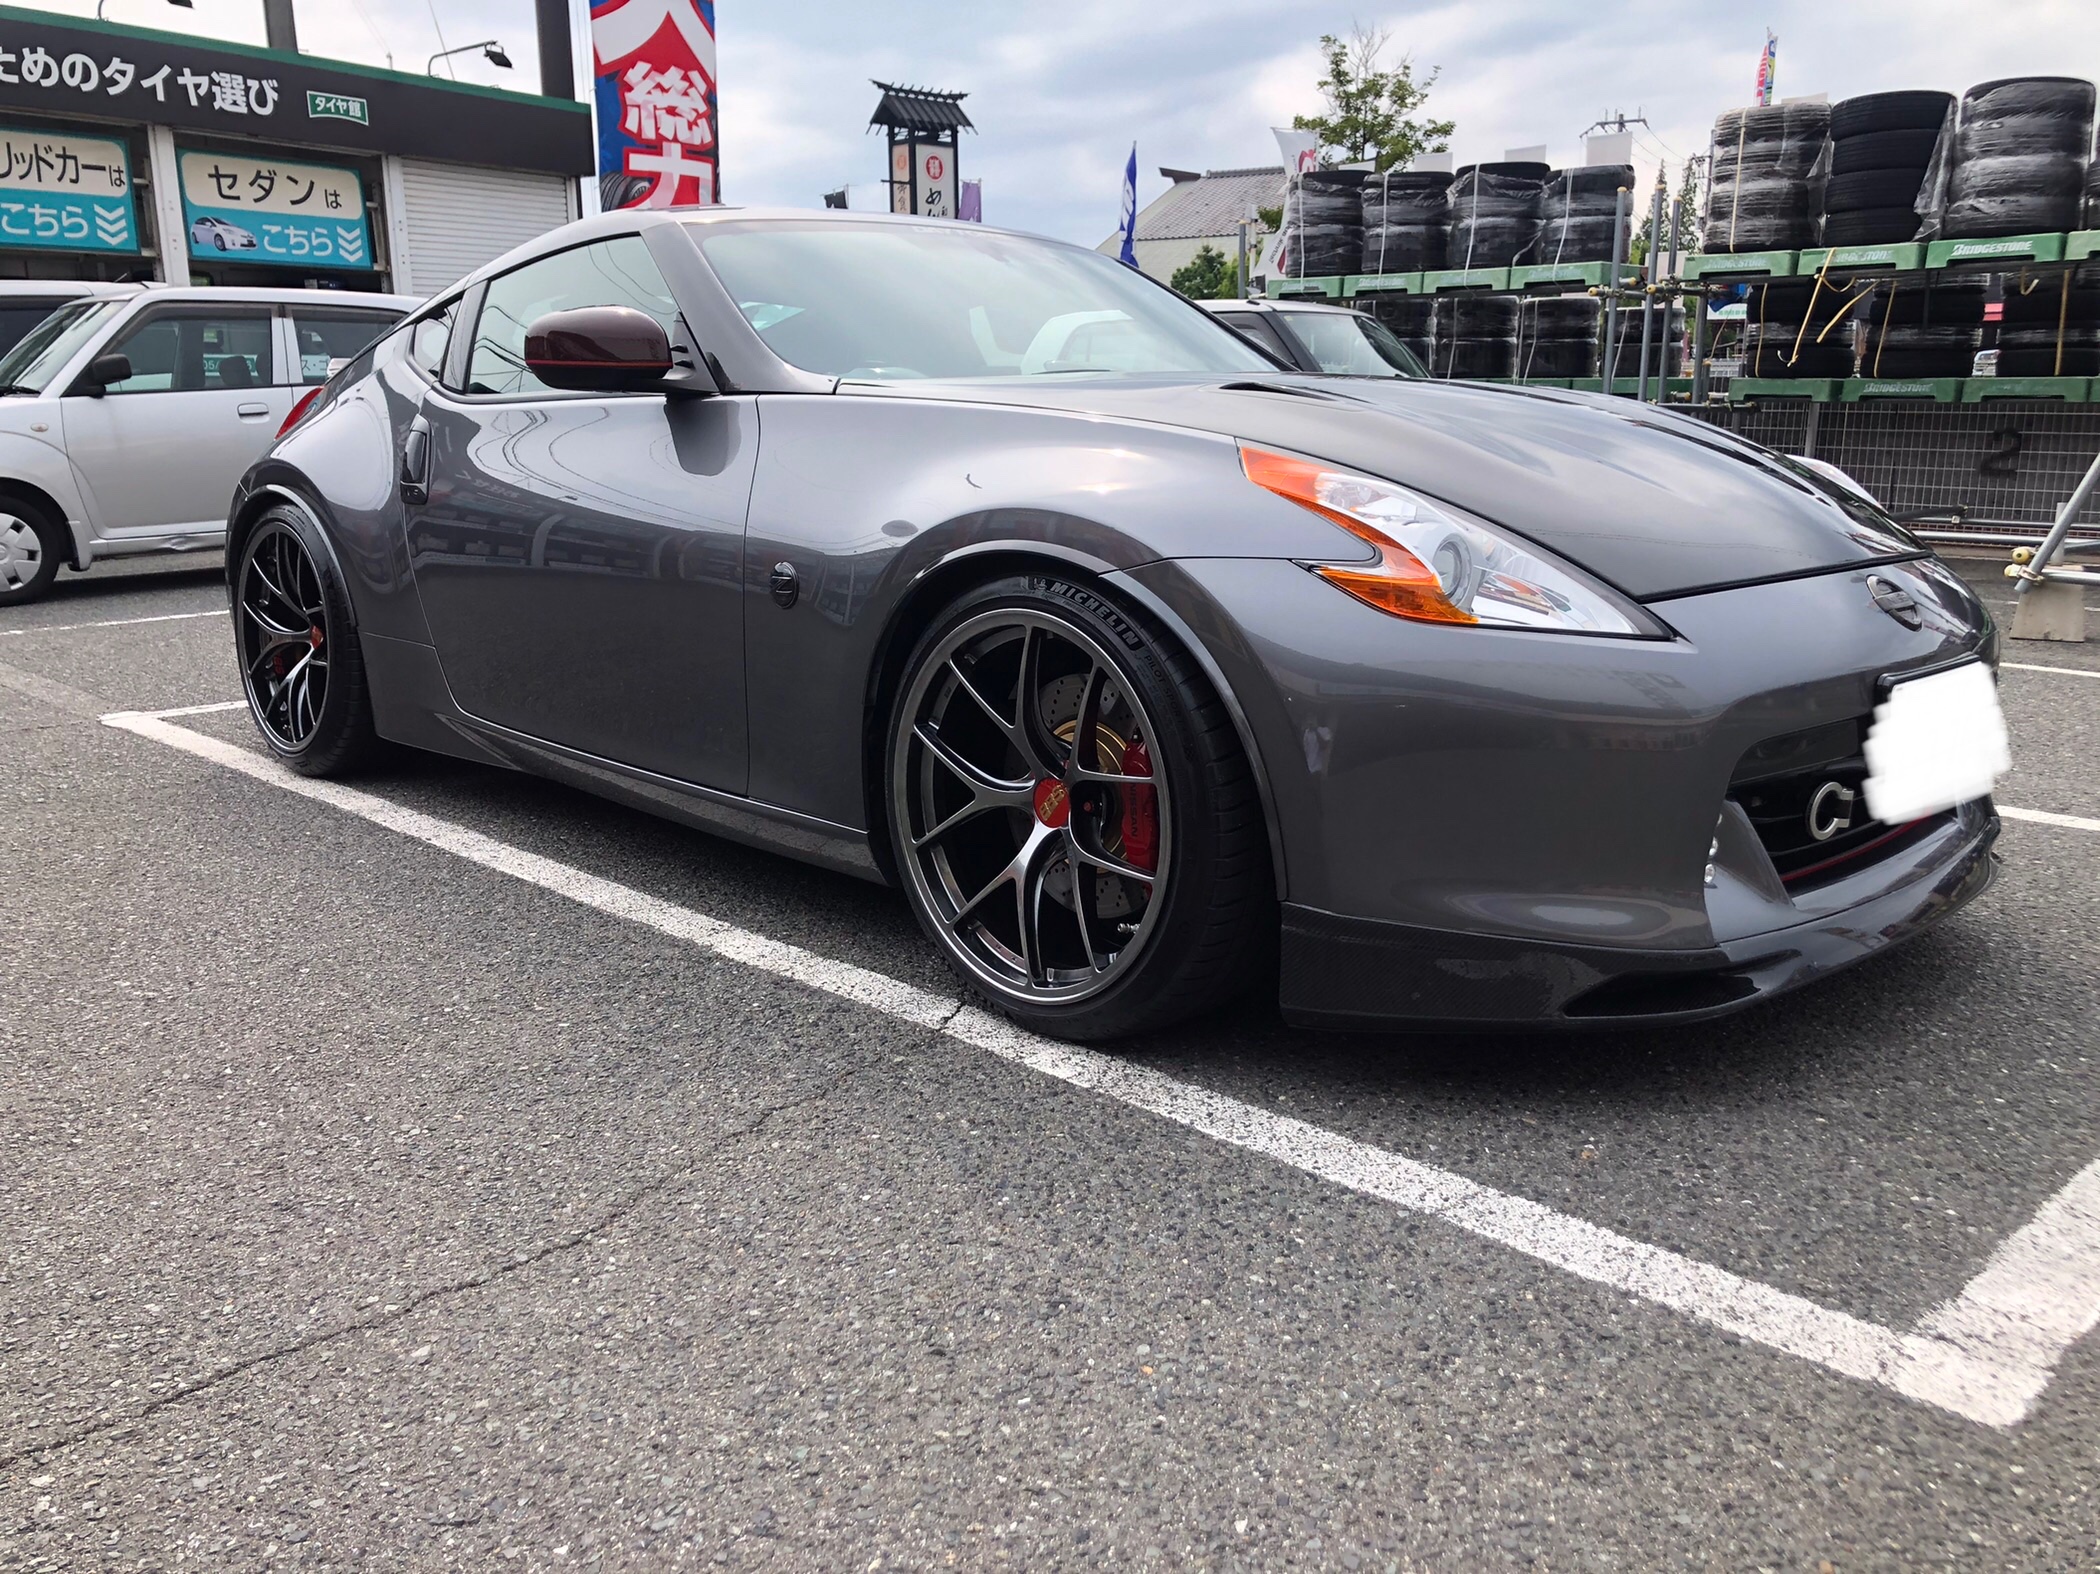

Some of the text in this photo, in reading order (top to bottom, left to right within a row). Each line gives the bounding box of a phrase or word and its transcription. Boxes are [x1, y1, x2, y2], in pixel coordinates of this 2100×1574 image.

[315, 96, 362, 117] タイヤ館
[0, 202, 89, 238] こちら
[262, 224, 333, 257] こちら
[1951, 241, 2033, 256] BRIDGESTONE
[1979, 428, 2021, 479] 2
[1050, 582, 1140, 645] MICHELIN
[1144, 655, 1167, 684] PILOT
